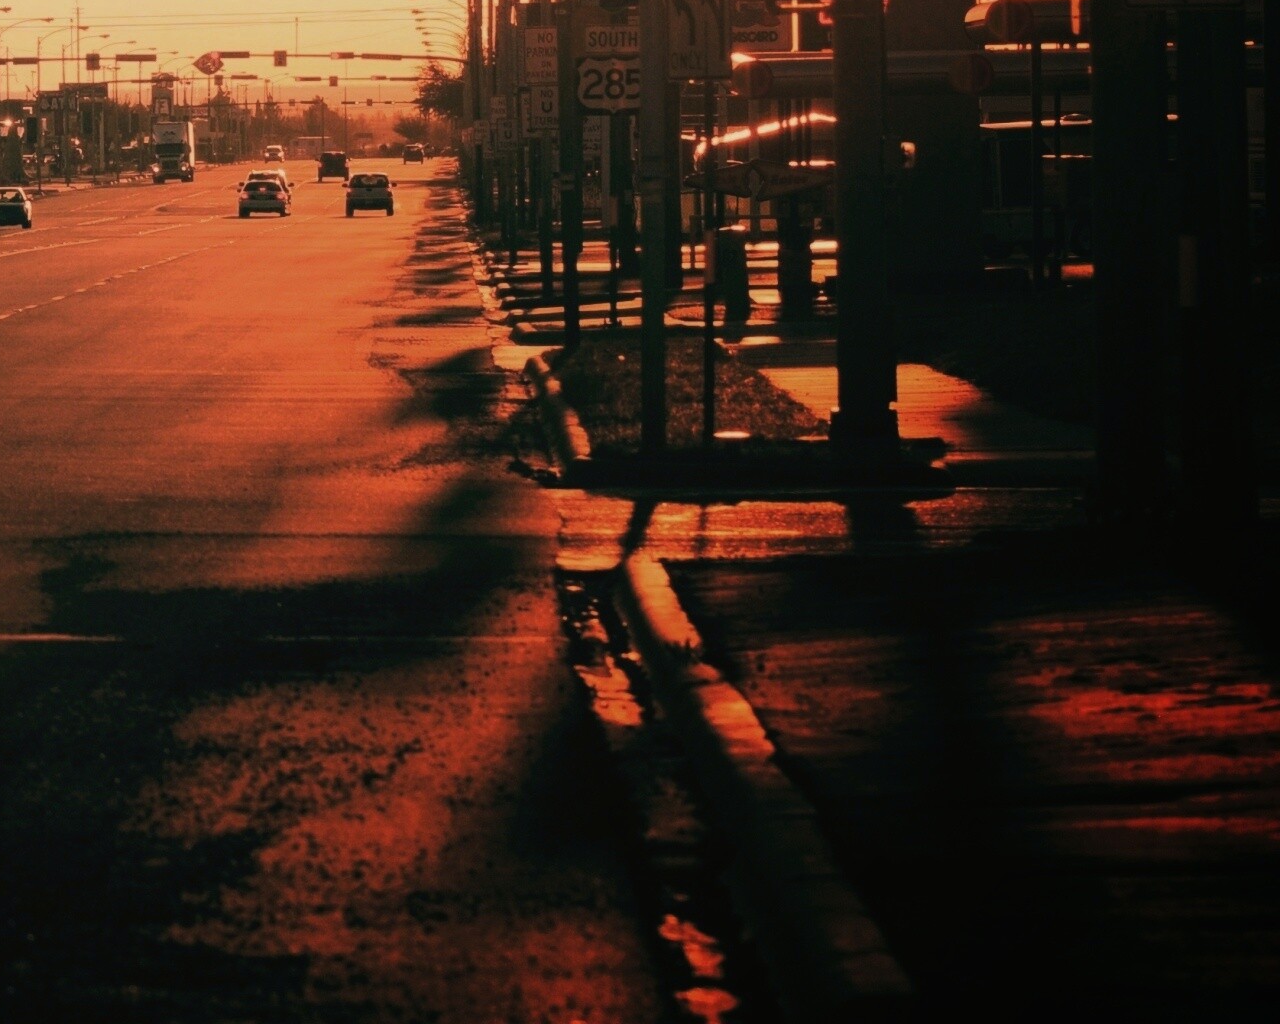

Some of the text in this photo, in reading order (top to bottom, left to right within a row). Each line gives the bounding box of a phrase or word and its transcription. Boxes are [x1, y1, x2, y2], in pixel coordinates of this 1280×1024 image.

[537, 32, 554, 44] NO
[588, 31, 638, 47] SOUTH
[526, 46, 557, 58] PARKIN
[582, 68, 640, 100] 285
[540, 89, 553, 99] NO
[541, 101, 553, 113] U
